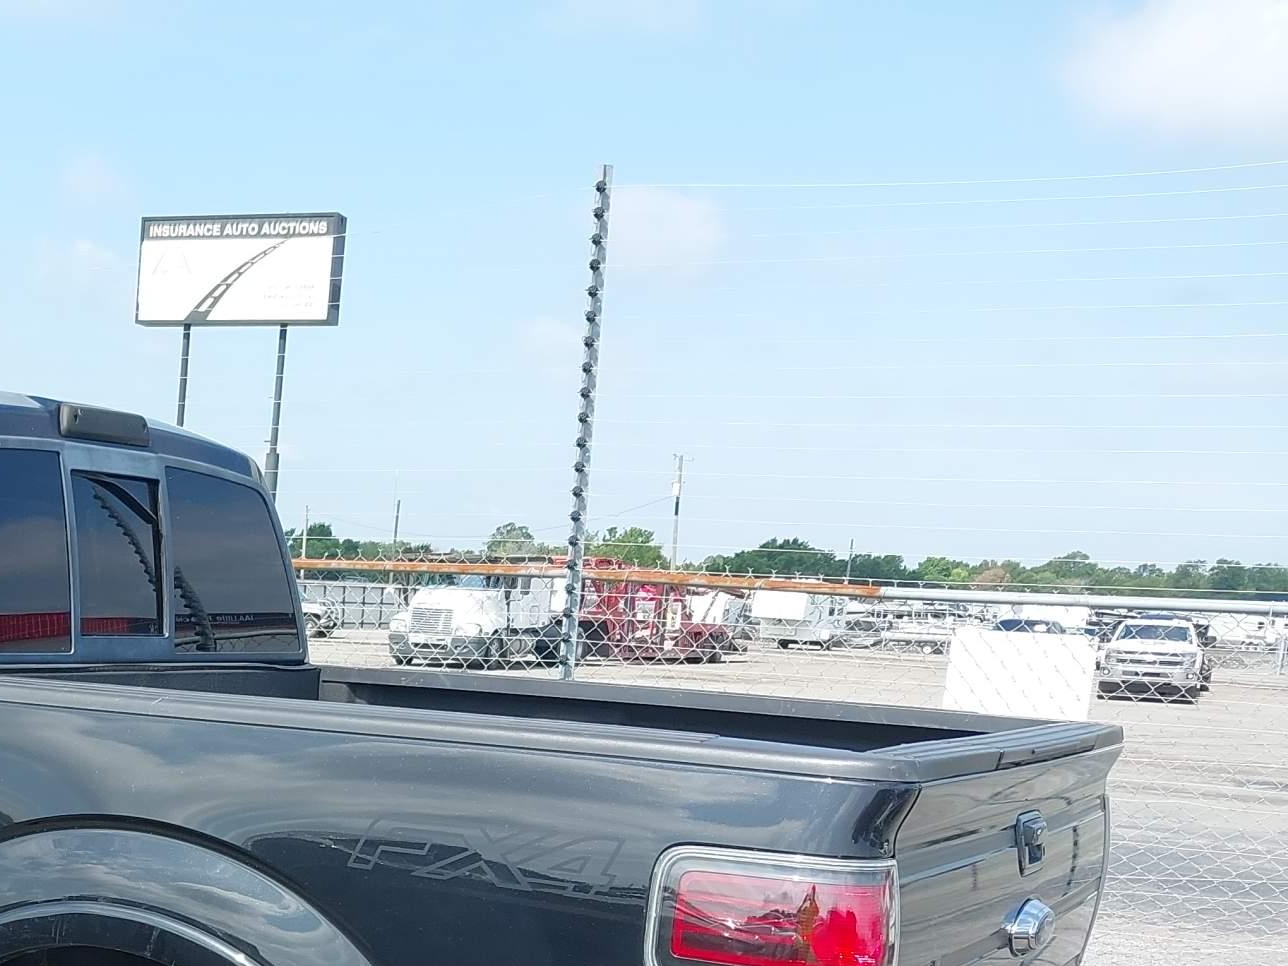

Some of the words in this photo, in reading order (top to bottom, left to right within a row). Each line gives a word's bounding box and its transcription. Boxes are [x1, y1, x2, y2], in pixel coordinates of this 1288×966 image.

[149, 222, 222, 238] INSURANCE
[223, 222, 259, 236] AUTO
[260, 220, 329, 236] AUCTIONS
[346, 817, 627, 904] FX4
